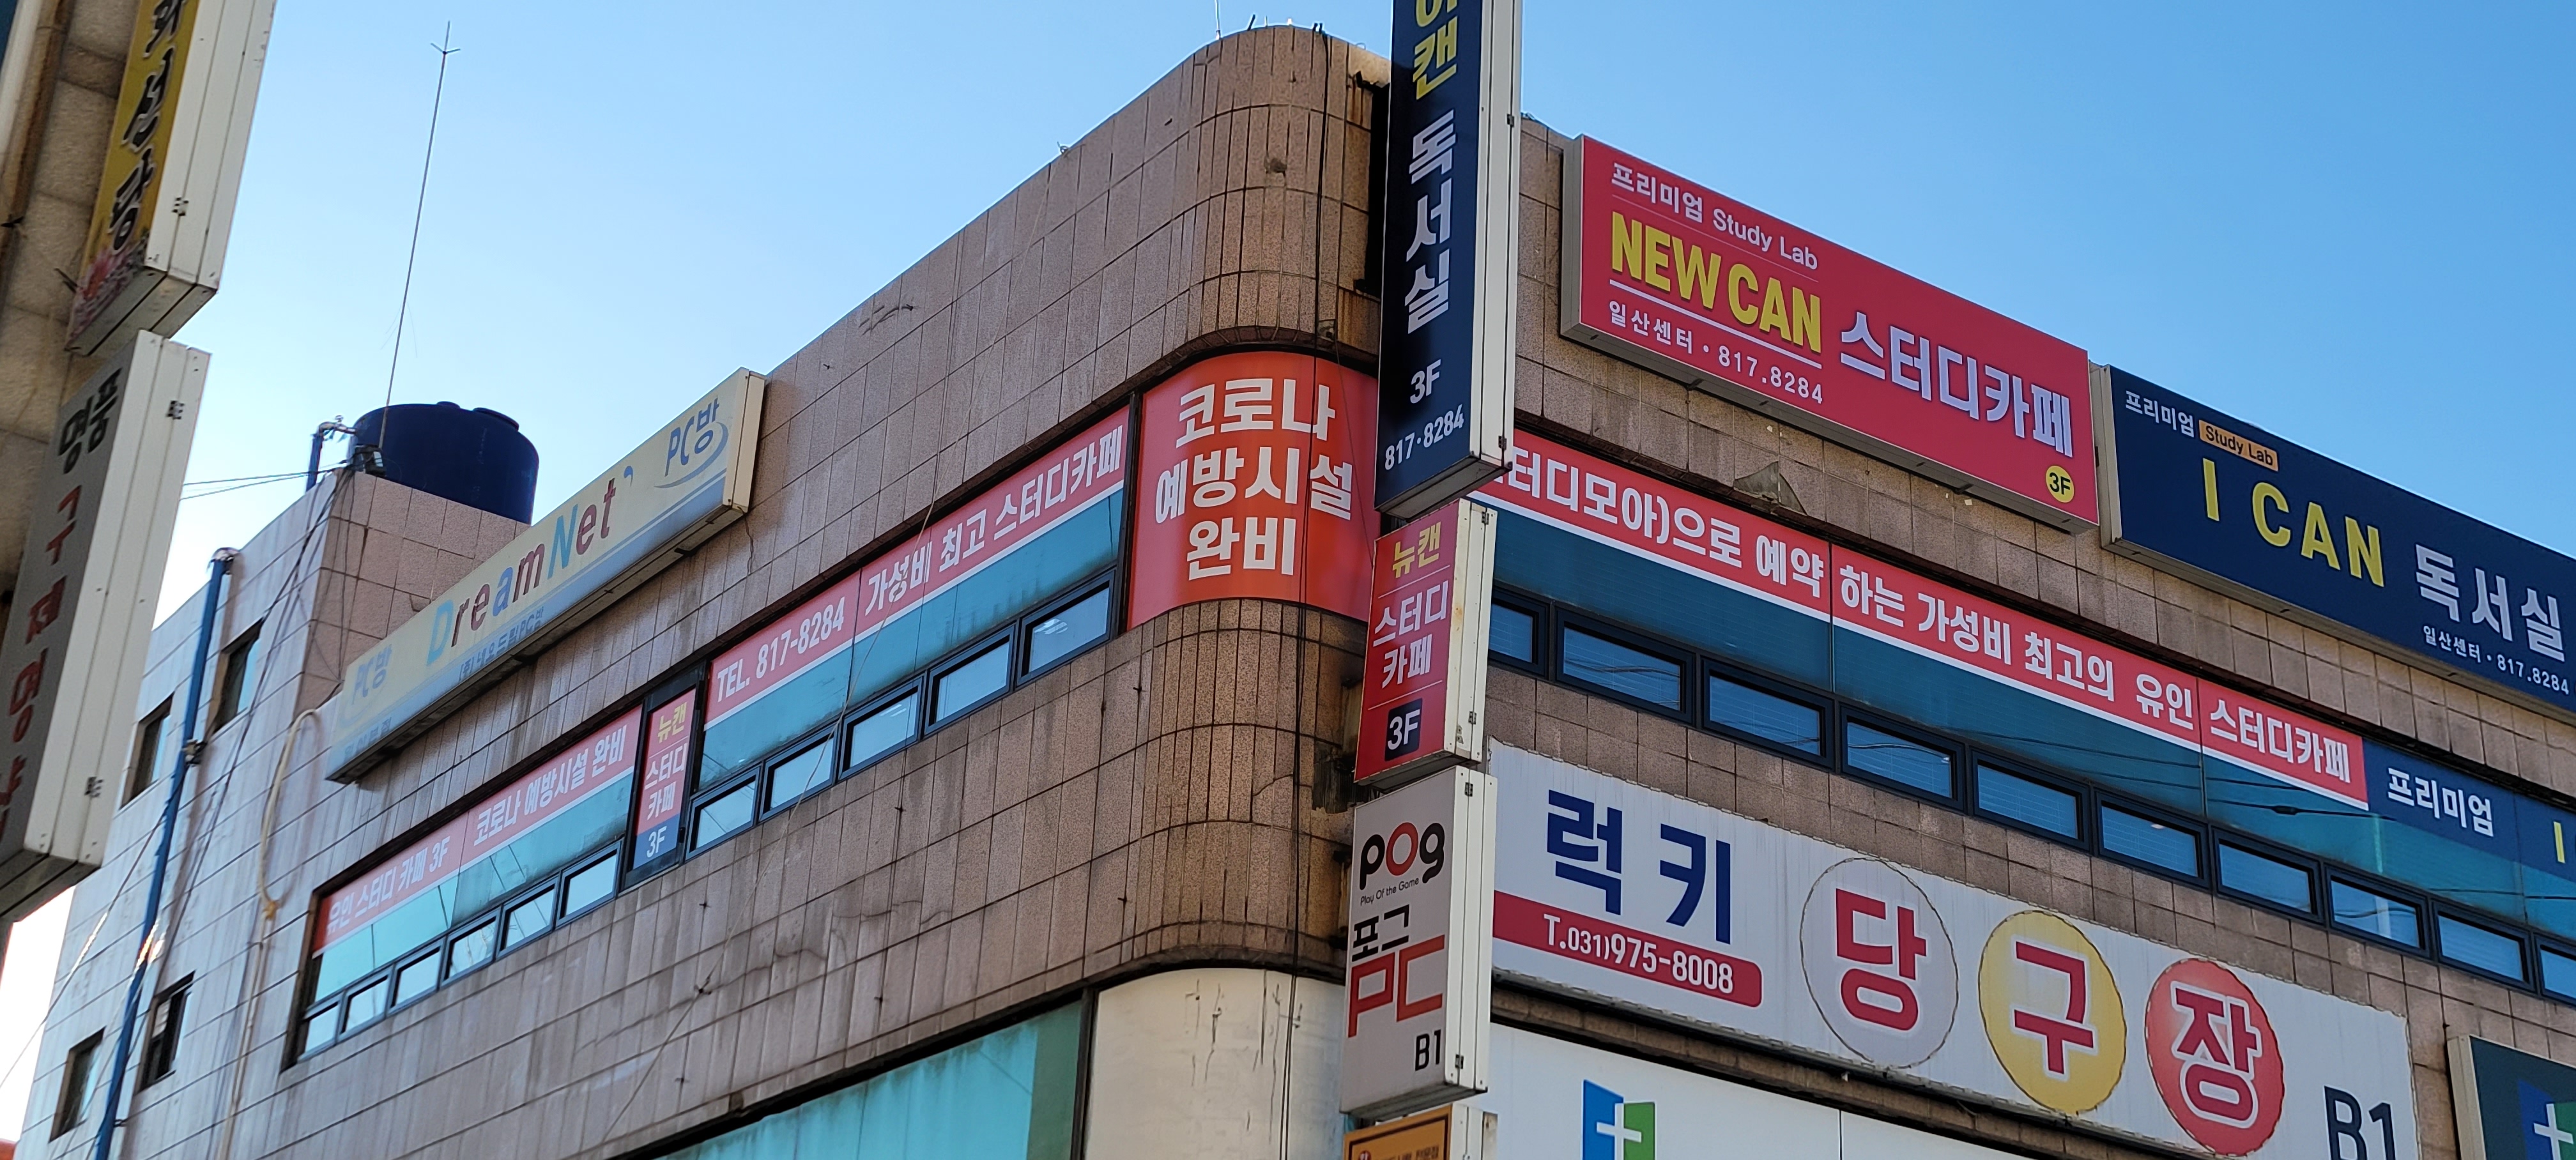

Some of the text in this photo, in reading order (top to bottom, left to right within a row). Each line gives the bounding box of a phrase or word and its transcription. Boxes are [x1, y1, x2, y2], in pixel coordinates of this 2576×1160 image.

[1405, 109, 1456, 335] 독서실
[1611, 162, 1818, 271] 프리미엄 Study Lab
[1612, 210, 1821, 353] NEW CAN
[1410, 359, 1441, 404] 3F
[1609, 300, 1823, 404] 일산센터 817.8284
[1840, 311, 2073, 459] 스터디카페
[664, 397, 719, 477] PC방
[1176, 378, 1336, 448] 코로나
[2125, 390, 2274, 466] 프리미엄 Study Lab
[1155, 446, 1353, 524] 예방시설
[2048, 470, 2071, 496] 3F
[864, 425, 1123, 616] 가성비 최고 스터디카페
[1186, 517, 1296, 581] 완비
[1392, 521, 1441, 578] 뉴캔
[2202, 457, 2384, 588] I CAN
[1372, 580, 1449, 647] 스터디
[1493, 446, 2351, 784] 터디모아)으로 예약 하는 가성비 최고의 유인 스터디카페
[2415, 544, 2565, 662] 독서실
[351, 643, 392, 705] PC방
[716, 597, 845, 702] TEL. 817-8284
[1382, 634, 1432, 689] 카페
[2423, 625, 2569, 695] 일산센터 817.8284
[657, 701, 686, 742] 뉴캔
[1388, 708, 1420, 751] 3F
[473, 724, 627, 846] 코로나 예방시설 완비
[645, 742, 687, 790] 스터디
[647, 781, 675, 821] 카페
[2388, 767, 2494, 837] 프리미엄
[646, 825, 667, 858] 3F
[327, 836, 450, 936] 유인 스터디 카페 3F
[1360, 878, 1419, 906] Play Of the Game
[1351, 904, 1409, 963] 포그
[1347, 935, 1445, 1039] PC
[1414, 1029, 1442, 1072] B1
[2323, 1085, 2396, 1160] B1
